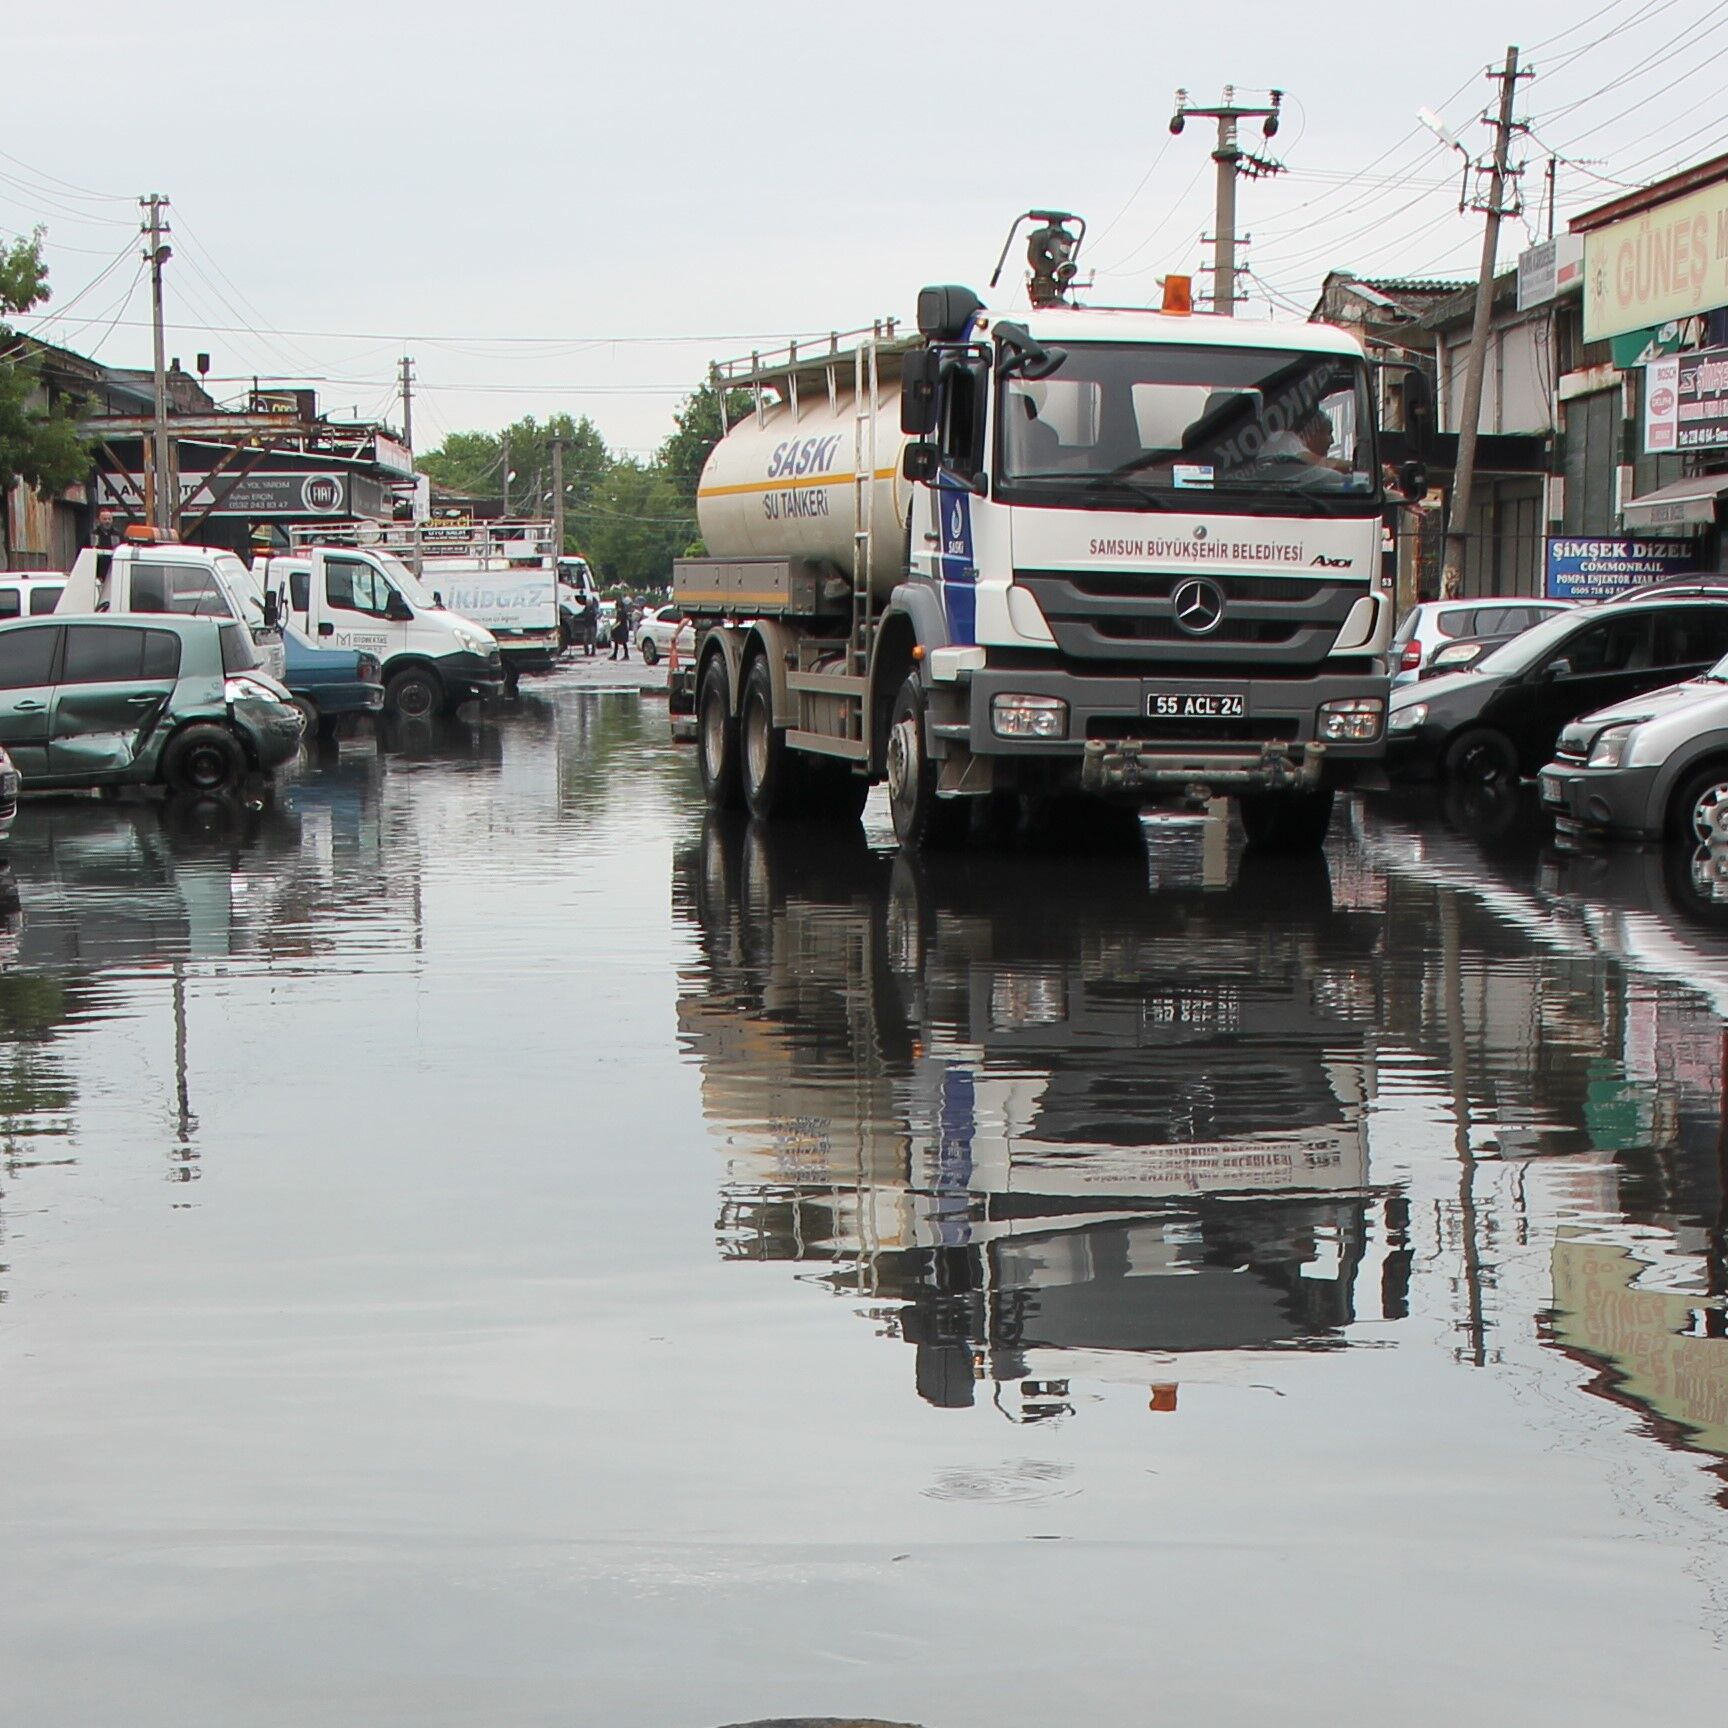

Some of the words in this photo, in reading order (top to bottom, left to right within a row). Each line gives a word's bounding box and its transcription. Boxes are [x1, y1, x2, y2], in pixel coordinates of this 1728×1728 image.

[1617, 211, 1710, 308] GÜNEŞ
[312, 486, 331, 501] FIAT
[764, 493, 779, 519] SU
[1090, 538, 1143, 556] SAMSUN
[1146, 537, 1229, 562] BÜYÜKŞEHİR
[1232, 540, 1303, 561] BELEDİYESİ
[1557, 574, 1586, 584] POMPA
[1157, 697, 1178, 713] 55
[1184, 697, 1215, 714] ACL
[1221, 697, 1242, 714] 24
